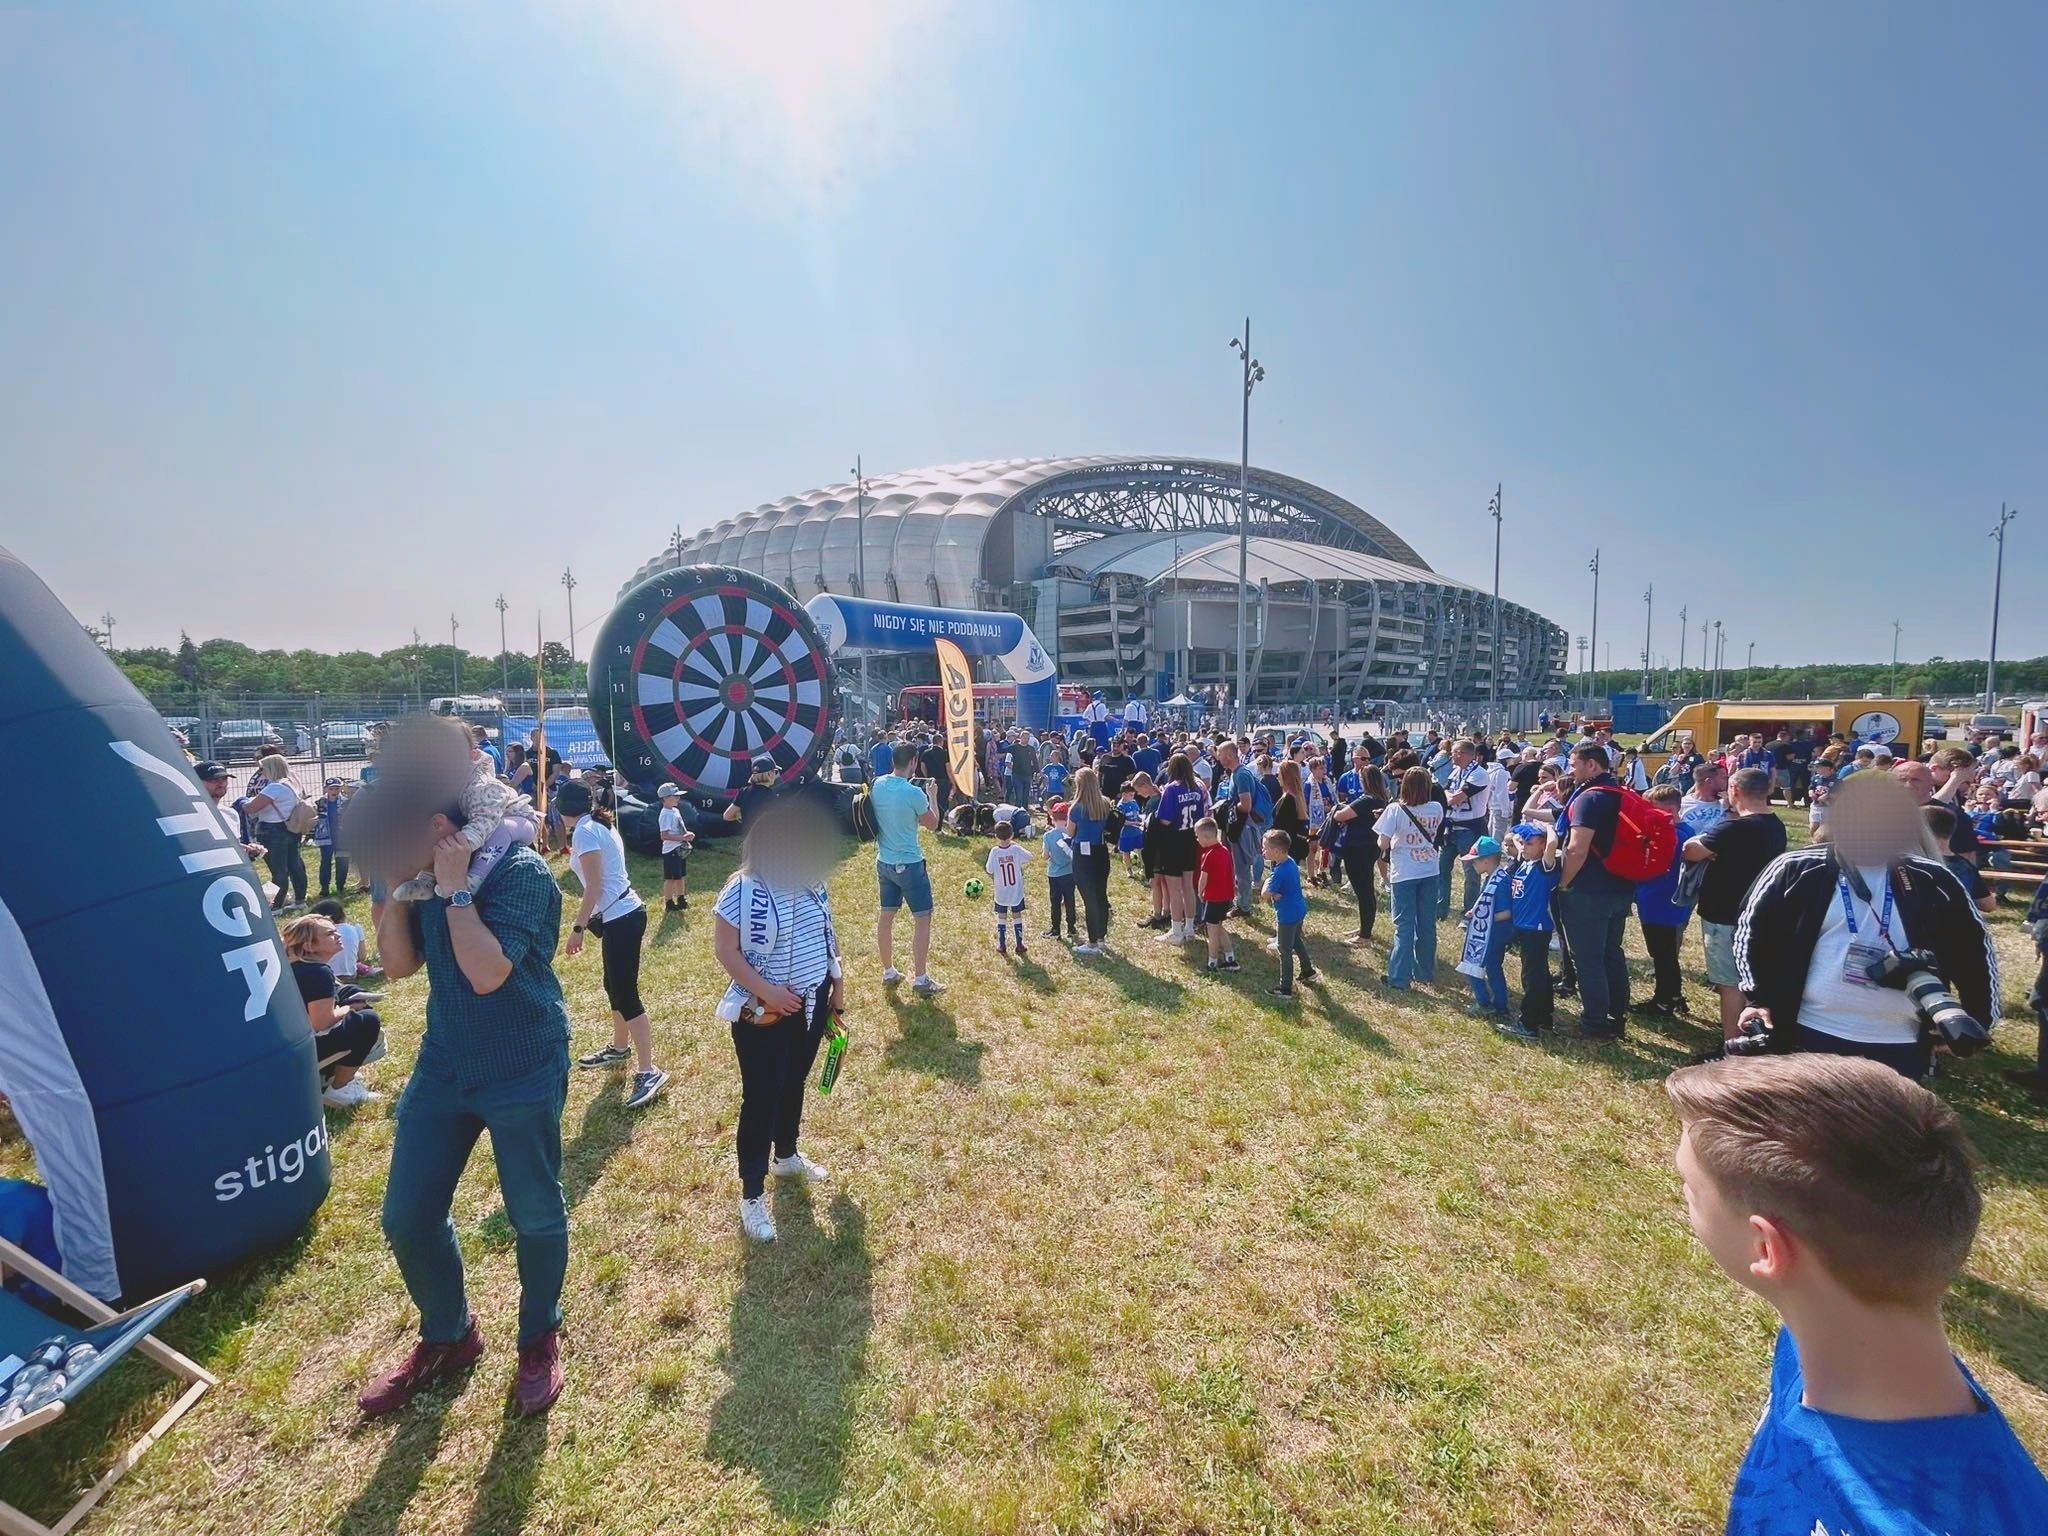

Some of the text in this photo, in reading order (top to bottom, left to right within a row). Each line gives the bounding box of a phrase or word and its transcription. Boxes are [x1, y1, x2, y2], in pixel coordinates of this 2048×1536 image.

[696, 574, 702, 584] 5
[727, 574, 738, 583] 20
[661, 589, 673, 598] 12
[788, 602, 797, 611] 18
[638, 612, 645, 622] 9
[873, 613, 1001, 638] NIGDY SIĘ NIE PODDAWAJ!
[812, 628, 818, 636] 4
[618, 645, 631, 655] 14
[824, 656, 833, 665] 13
[612, 683, 625, 693] 11
[623, 722, 631, 732] 8
[816, 750, 825, 759] 15
[639, 756, 651, 766] 16
[800, 776, 805, 784] 2
[702, 799, 713, 808] 19
[1000, 863, 1016, 887] 10
[109, 739, 282, 1022] STIGA
[1472, 892, 1496, 942] LECH
